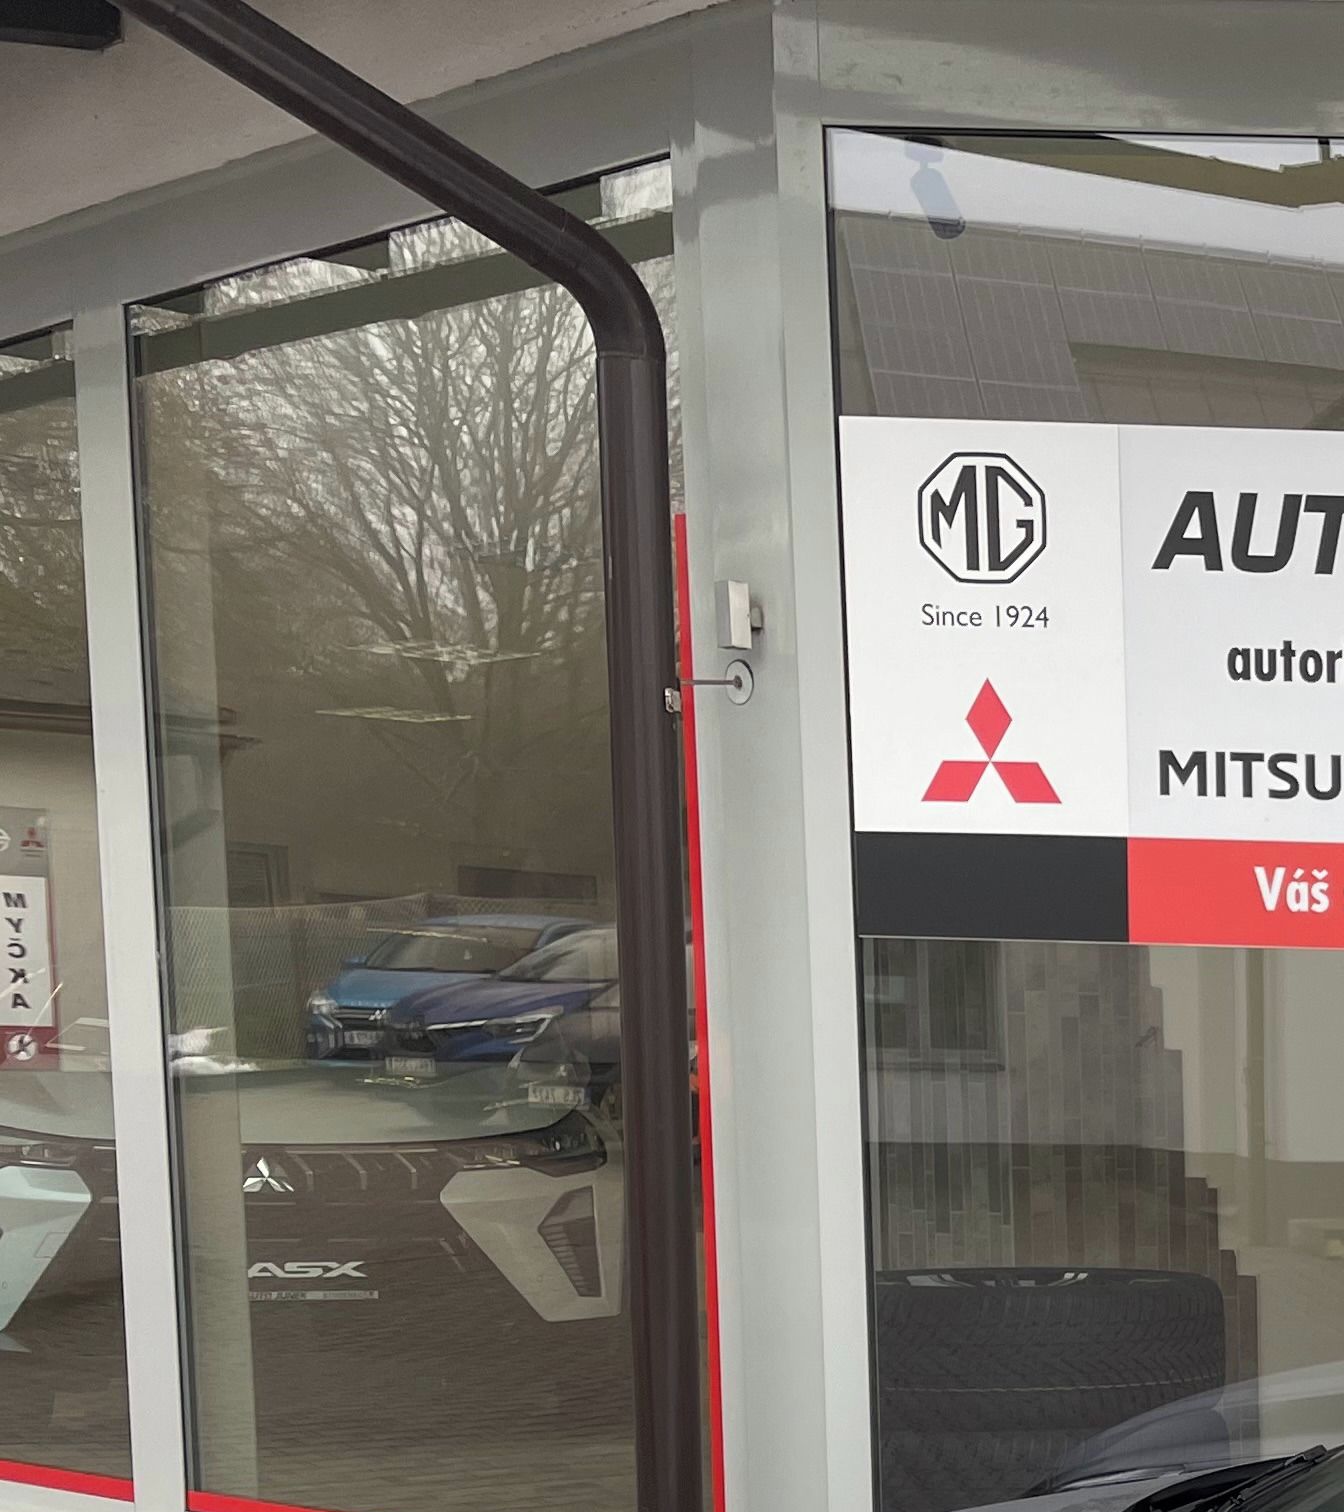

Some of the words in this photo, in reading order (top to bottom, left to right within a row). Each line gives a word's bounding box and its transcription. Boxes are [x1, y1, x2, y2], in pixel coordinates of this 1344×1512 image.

[927, 461, 1038, 575] MG
[921, 603, 982, 628] Since
[992, 604, 1050, 629] 1924
[1254, 866, 1330, 913] Váš
[247, 1260, 368, 1279] ASX
